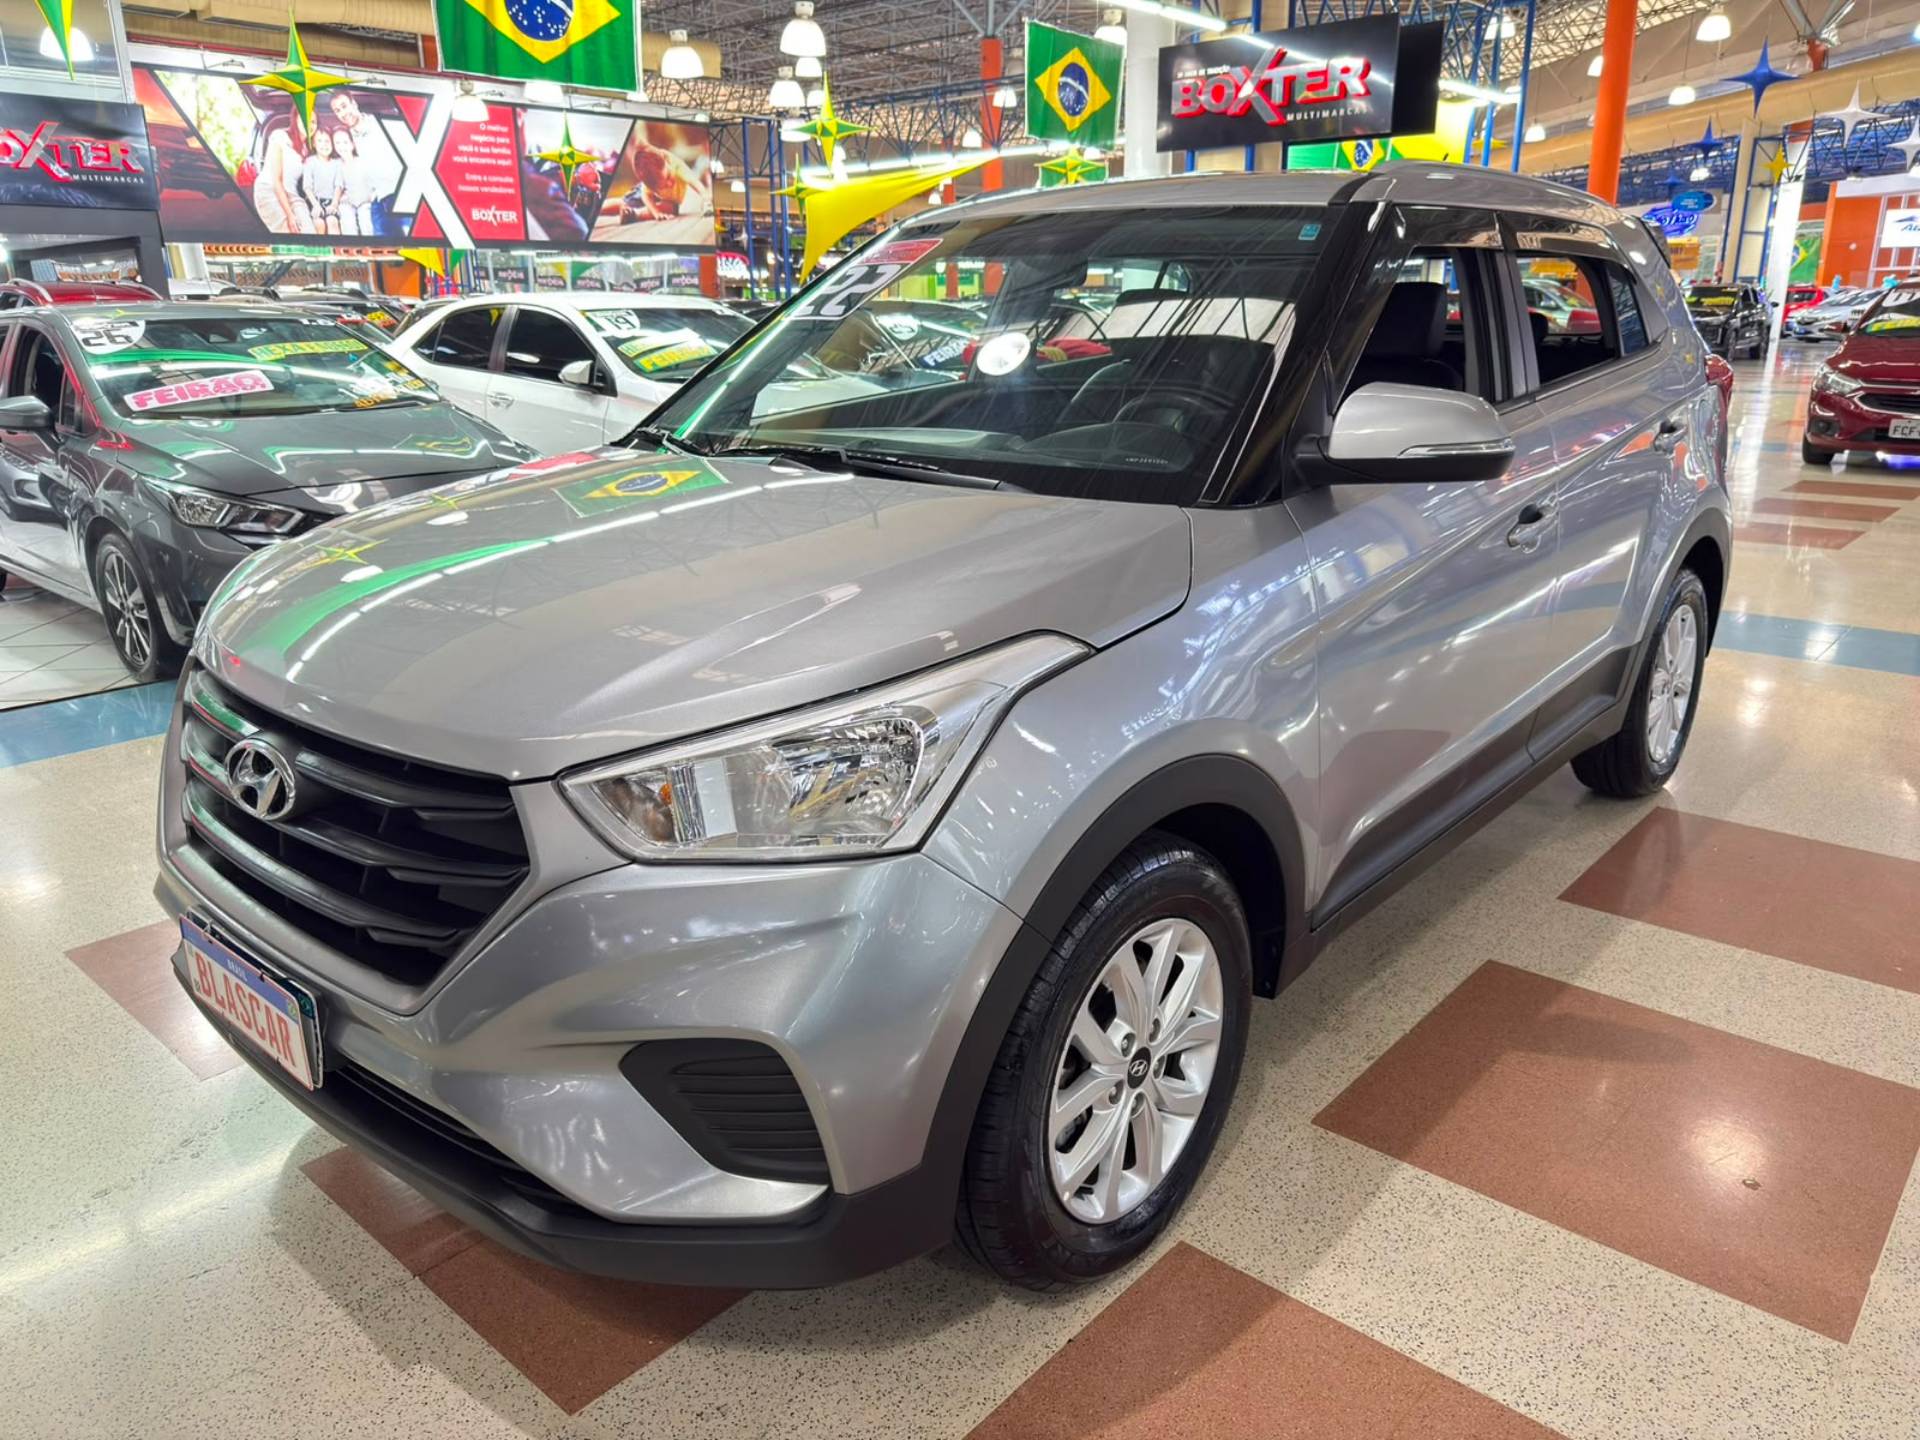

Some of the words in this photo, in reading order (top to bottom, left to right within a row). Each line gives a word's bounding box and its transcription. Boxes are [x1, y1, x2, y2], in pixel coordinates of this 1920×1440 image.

[1171, 48, 1371, 126] BOXTER
[1286, 108, 1373, 121] MULTIMARCAS
[72, 174, 144, 184] MULTIMARCAS
[471, 205, 518, 227] BOXTER
[133, 373, 266, 408] FEIRÃO
[195, 951, 296, 1067] BLASCAR
